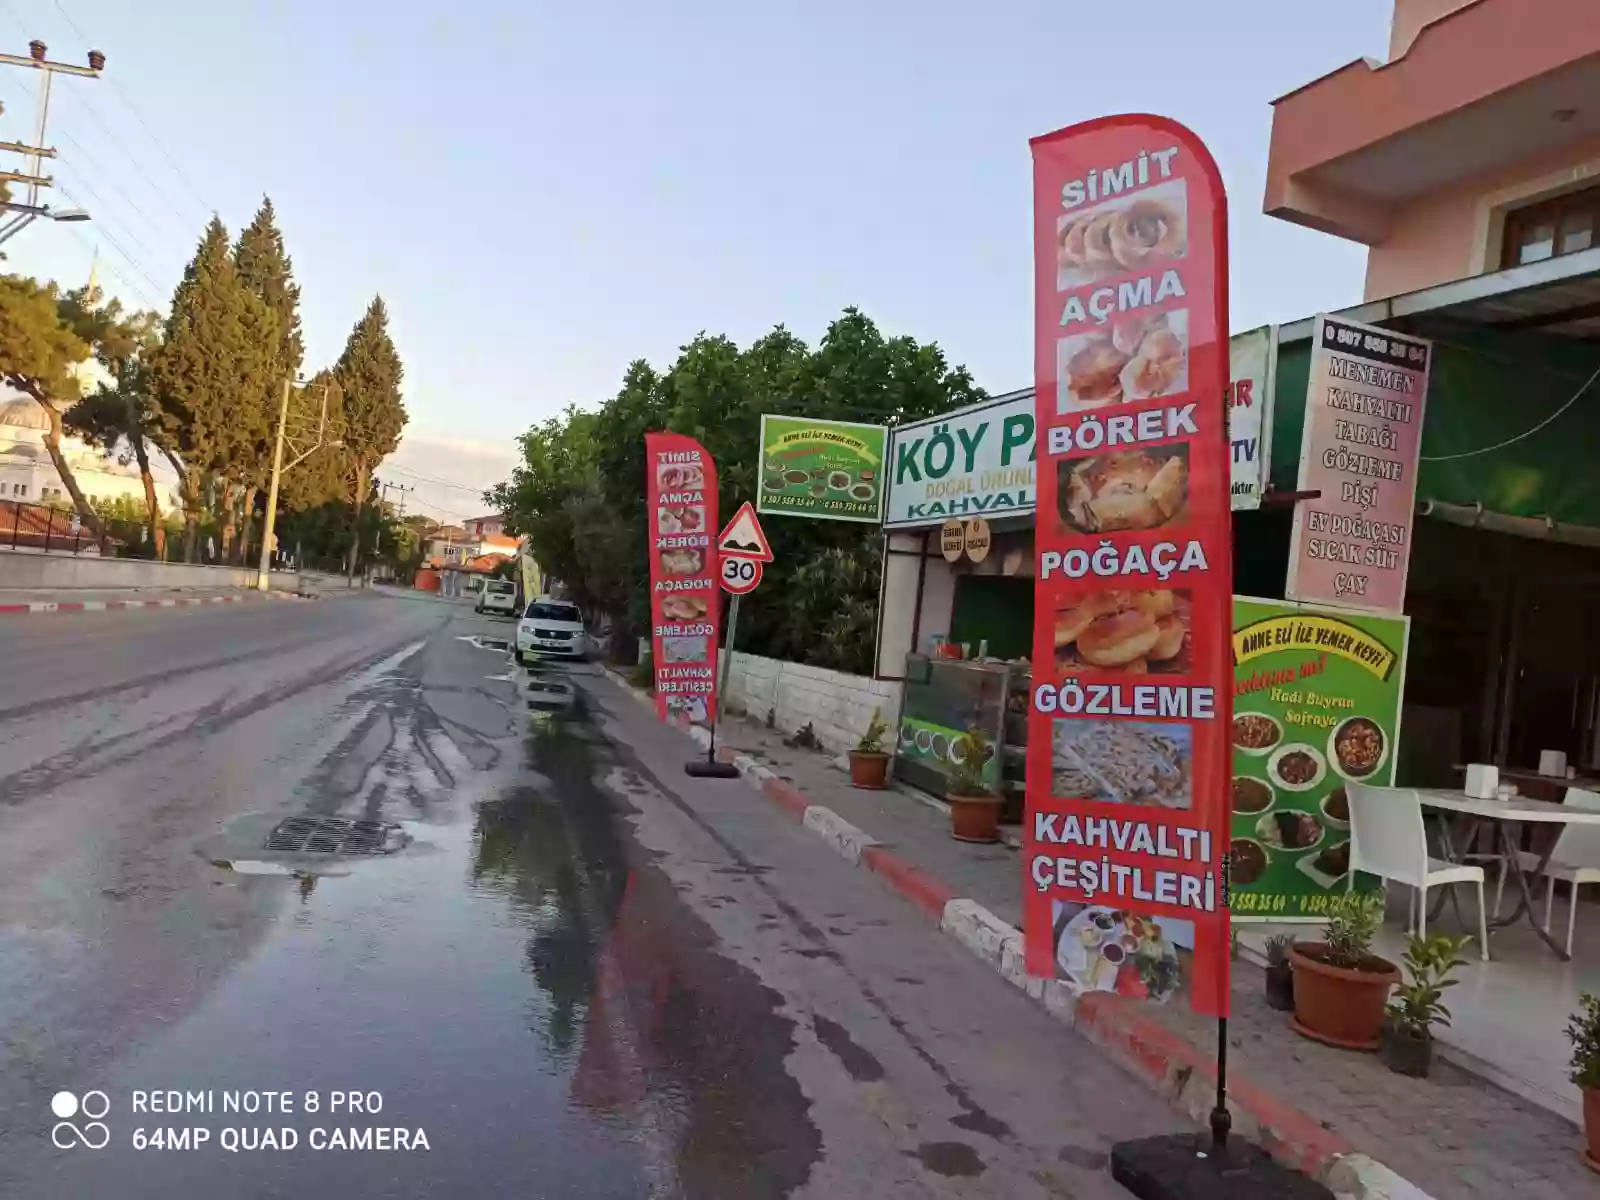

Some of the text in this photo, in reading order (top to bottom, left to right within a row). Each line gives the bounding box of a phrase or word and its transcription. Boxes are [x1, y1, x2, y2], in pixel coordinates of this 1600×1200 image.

[1061, 146, 1178, 209] SİMİT
[1059, 269, 1186, 326] AÇMA
[1328, 357, 1414, 393] MENEMEN
[1326, 387, 1412, 423] KAHVALTI
[1048, 404, 1199, 454] BÖREK
[1336, 419, 1398, 451] TABAĞI
[897, 414, 1036, 485] KÖY P
[1322, 445, 1402, 481] GÖZLEME
[908, 490, 1036, 518] KAHVAL
[1342, 479, 1379, 510] PİŞİ
[1308, 511, 1405, 546] EV POĞAÇASI
[725, 558, 754, 580] 30
[1041, 540, 1208, 581] POĞAÇA
[1308, 539, 1399, 570] SICAK SÜT
[1334, 573, 1368, 597] ÇAY
[1296, 622, 1314, 644] İLE
[1315, 627, 1354, 652] YEMEK
[1035, 678, 1215, 719] GÖZLEME
[1035, 812, 1211, 863] KAHVALTI
[1032, 855, 1216, 912] ÇEŞİTLERİ
